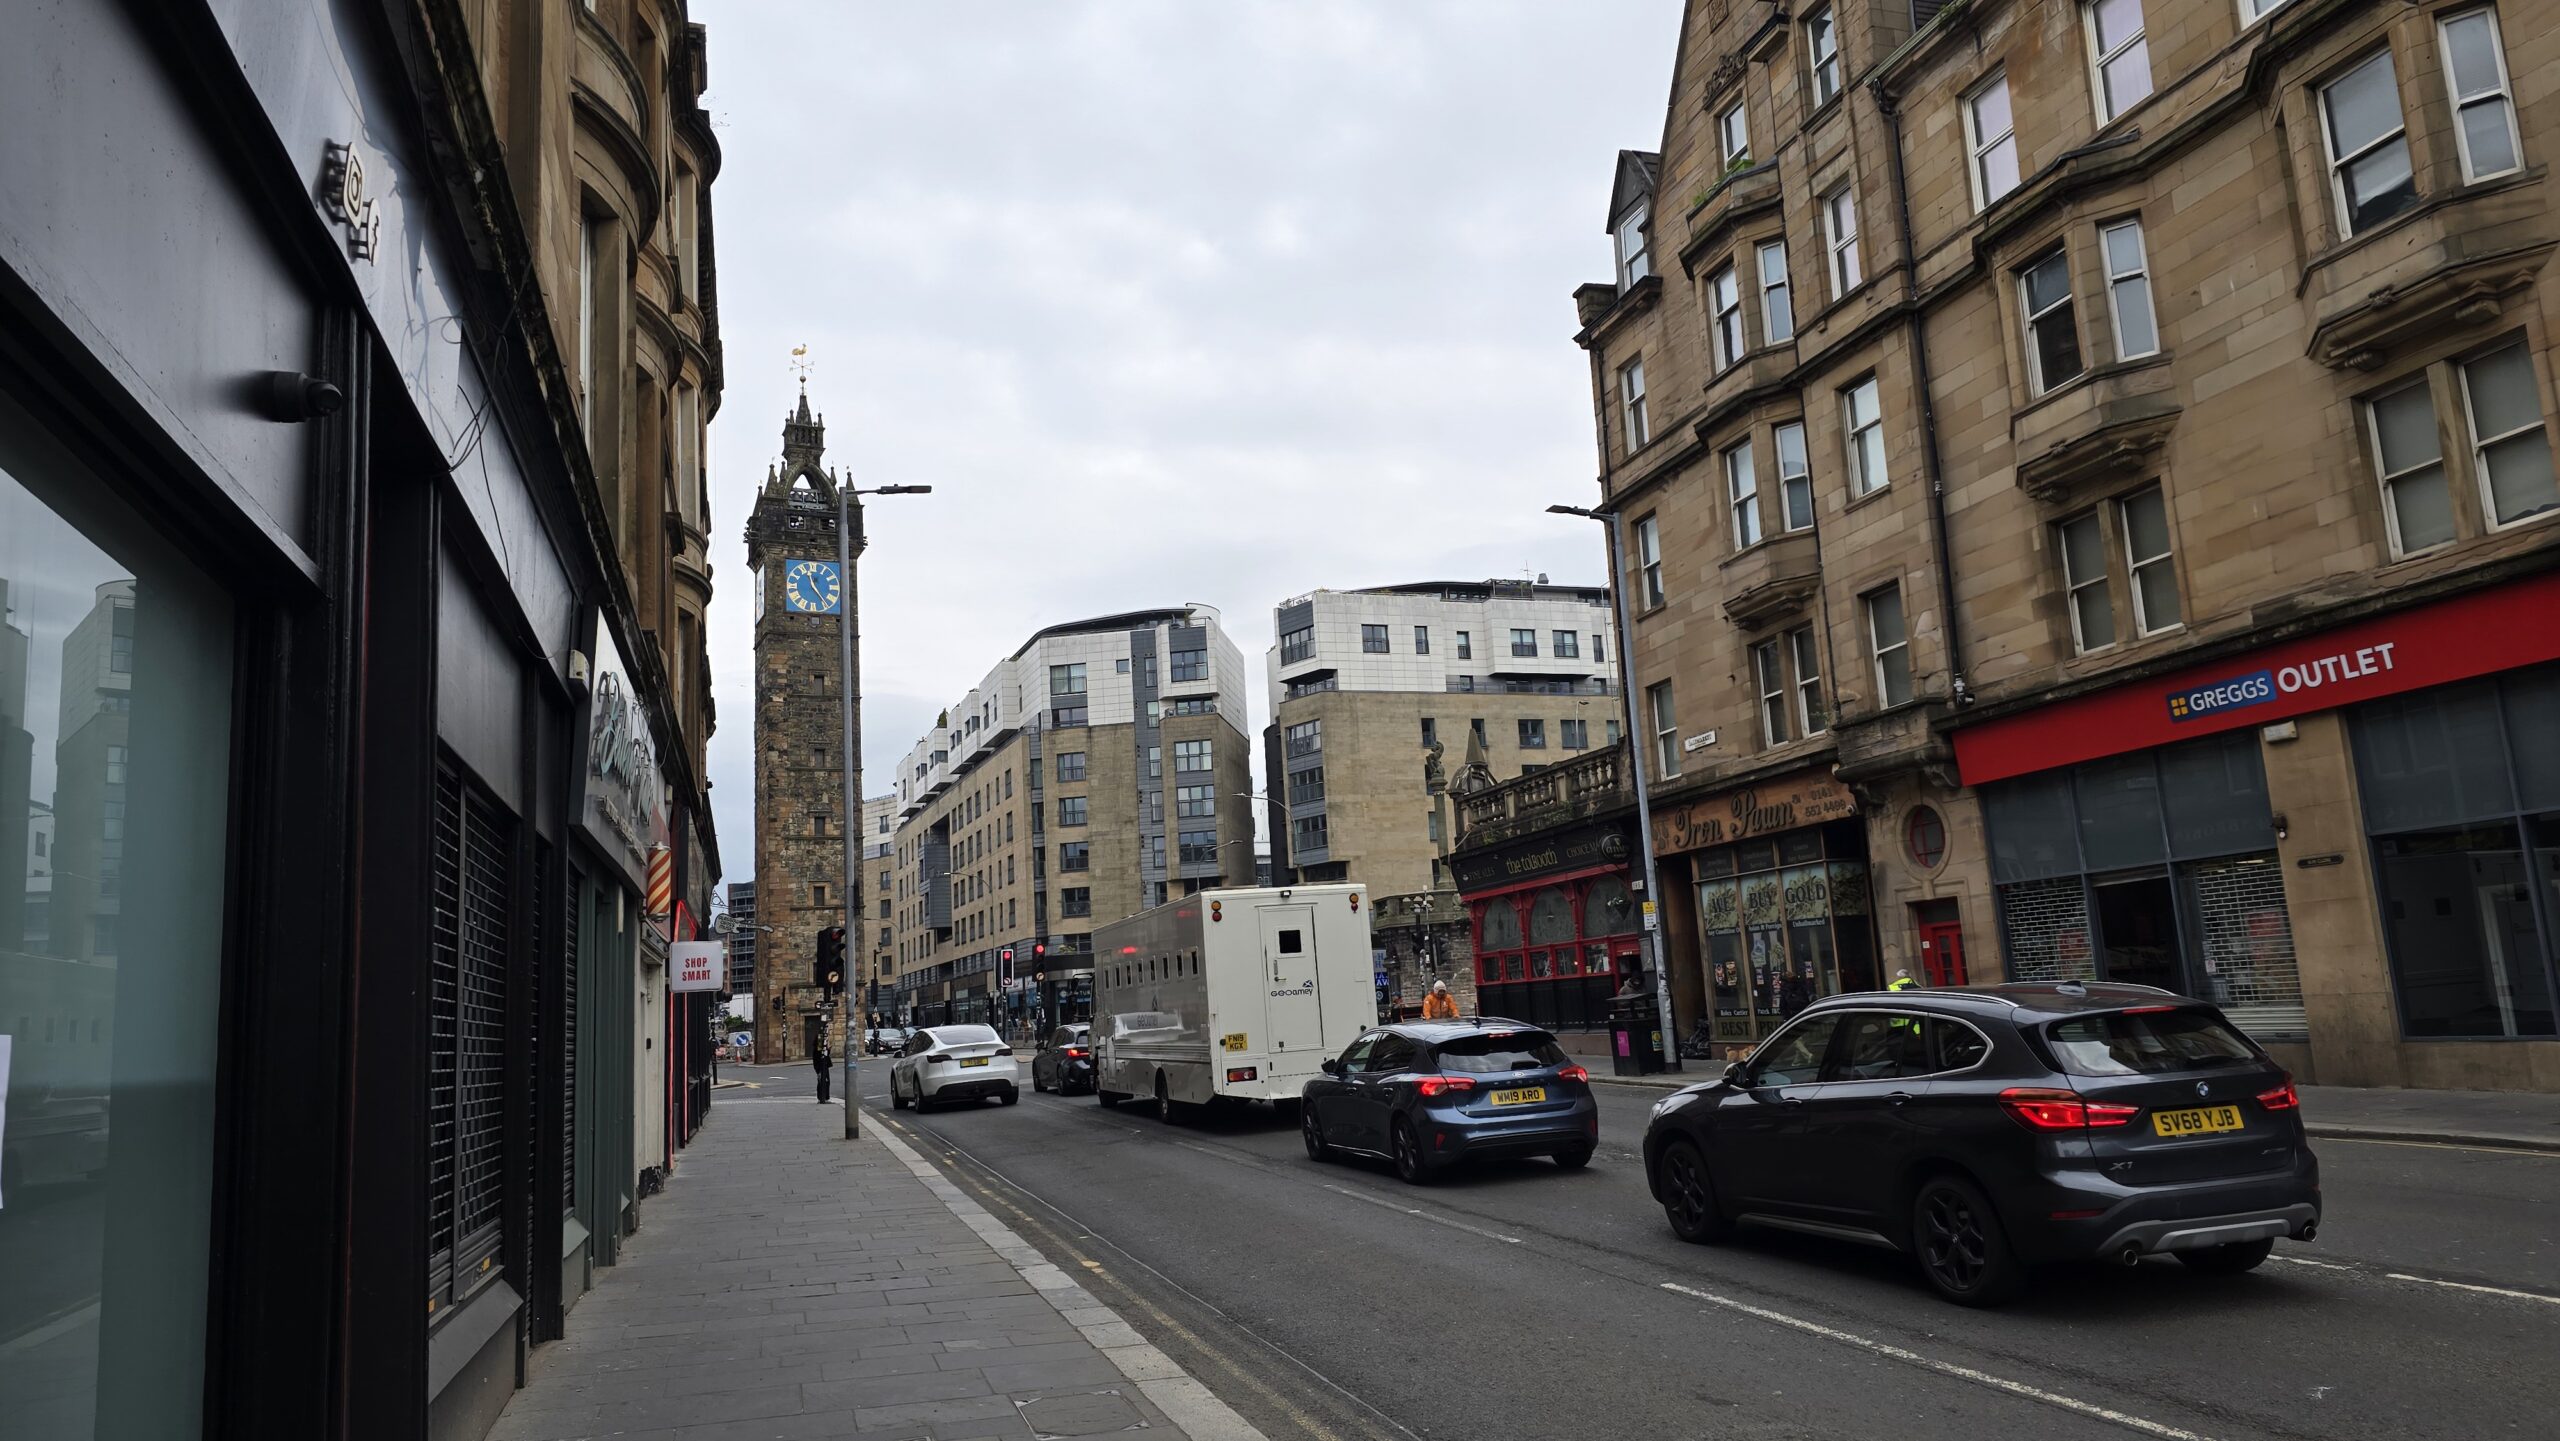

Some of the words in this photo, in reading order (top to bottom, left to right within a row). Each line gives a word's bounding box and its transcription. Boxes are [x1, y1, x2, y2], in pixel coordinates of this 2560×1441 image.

[2190, 676, 2270, 713] GREGGS
[2278, 642, 2395, 693] OUTLET
[1730, 789, 1797, 838] Pawn
[1506, 858, 1522, 875] the
[1748, 890, 1774, 909] BUY
[1785, 883, 1827, 904] GOLD
[685, 957, 707, 968] SHOP
[682, 969, 711, 982] SMART
[1722, 1021, 1750, 1036] BEST
[1228, 1033, 1244, 1042] FN19
[1229, 1042, 1244, 1050] KGX
[1522, 1089, 1540, 1101] ARO
[2160, 1111, 2202, 1132] SV68
[2204, 1109, 2235, 1128] YJB
